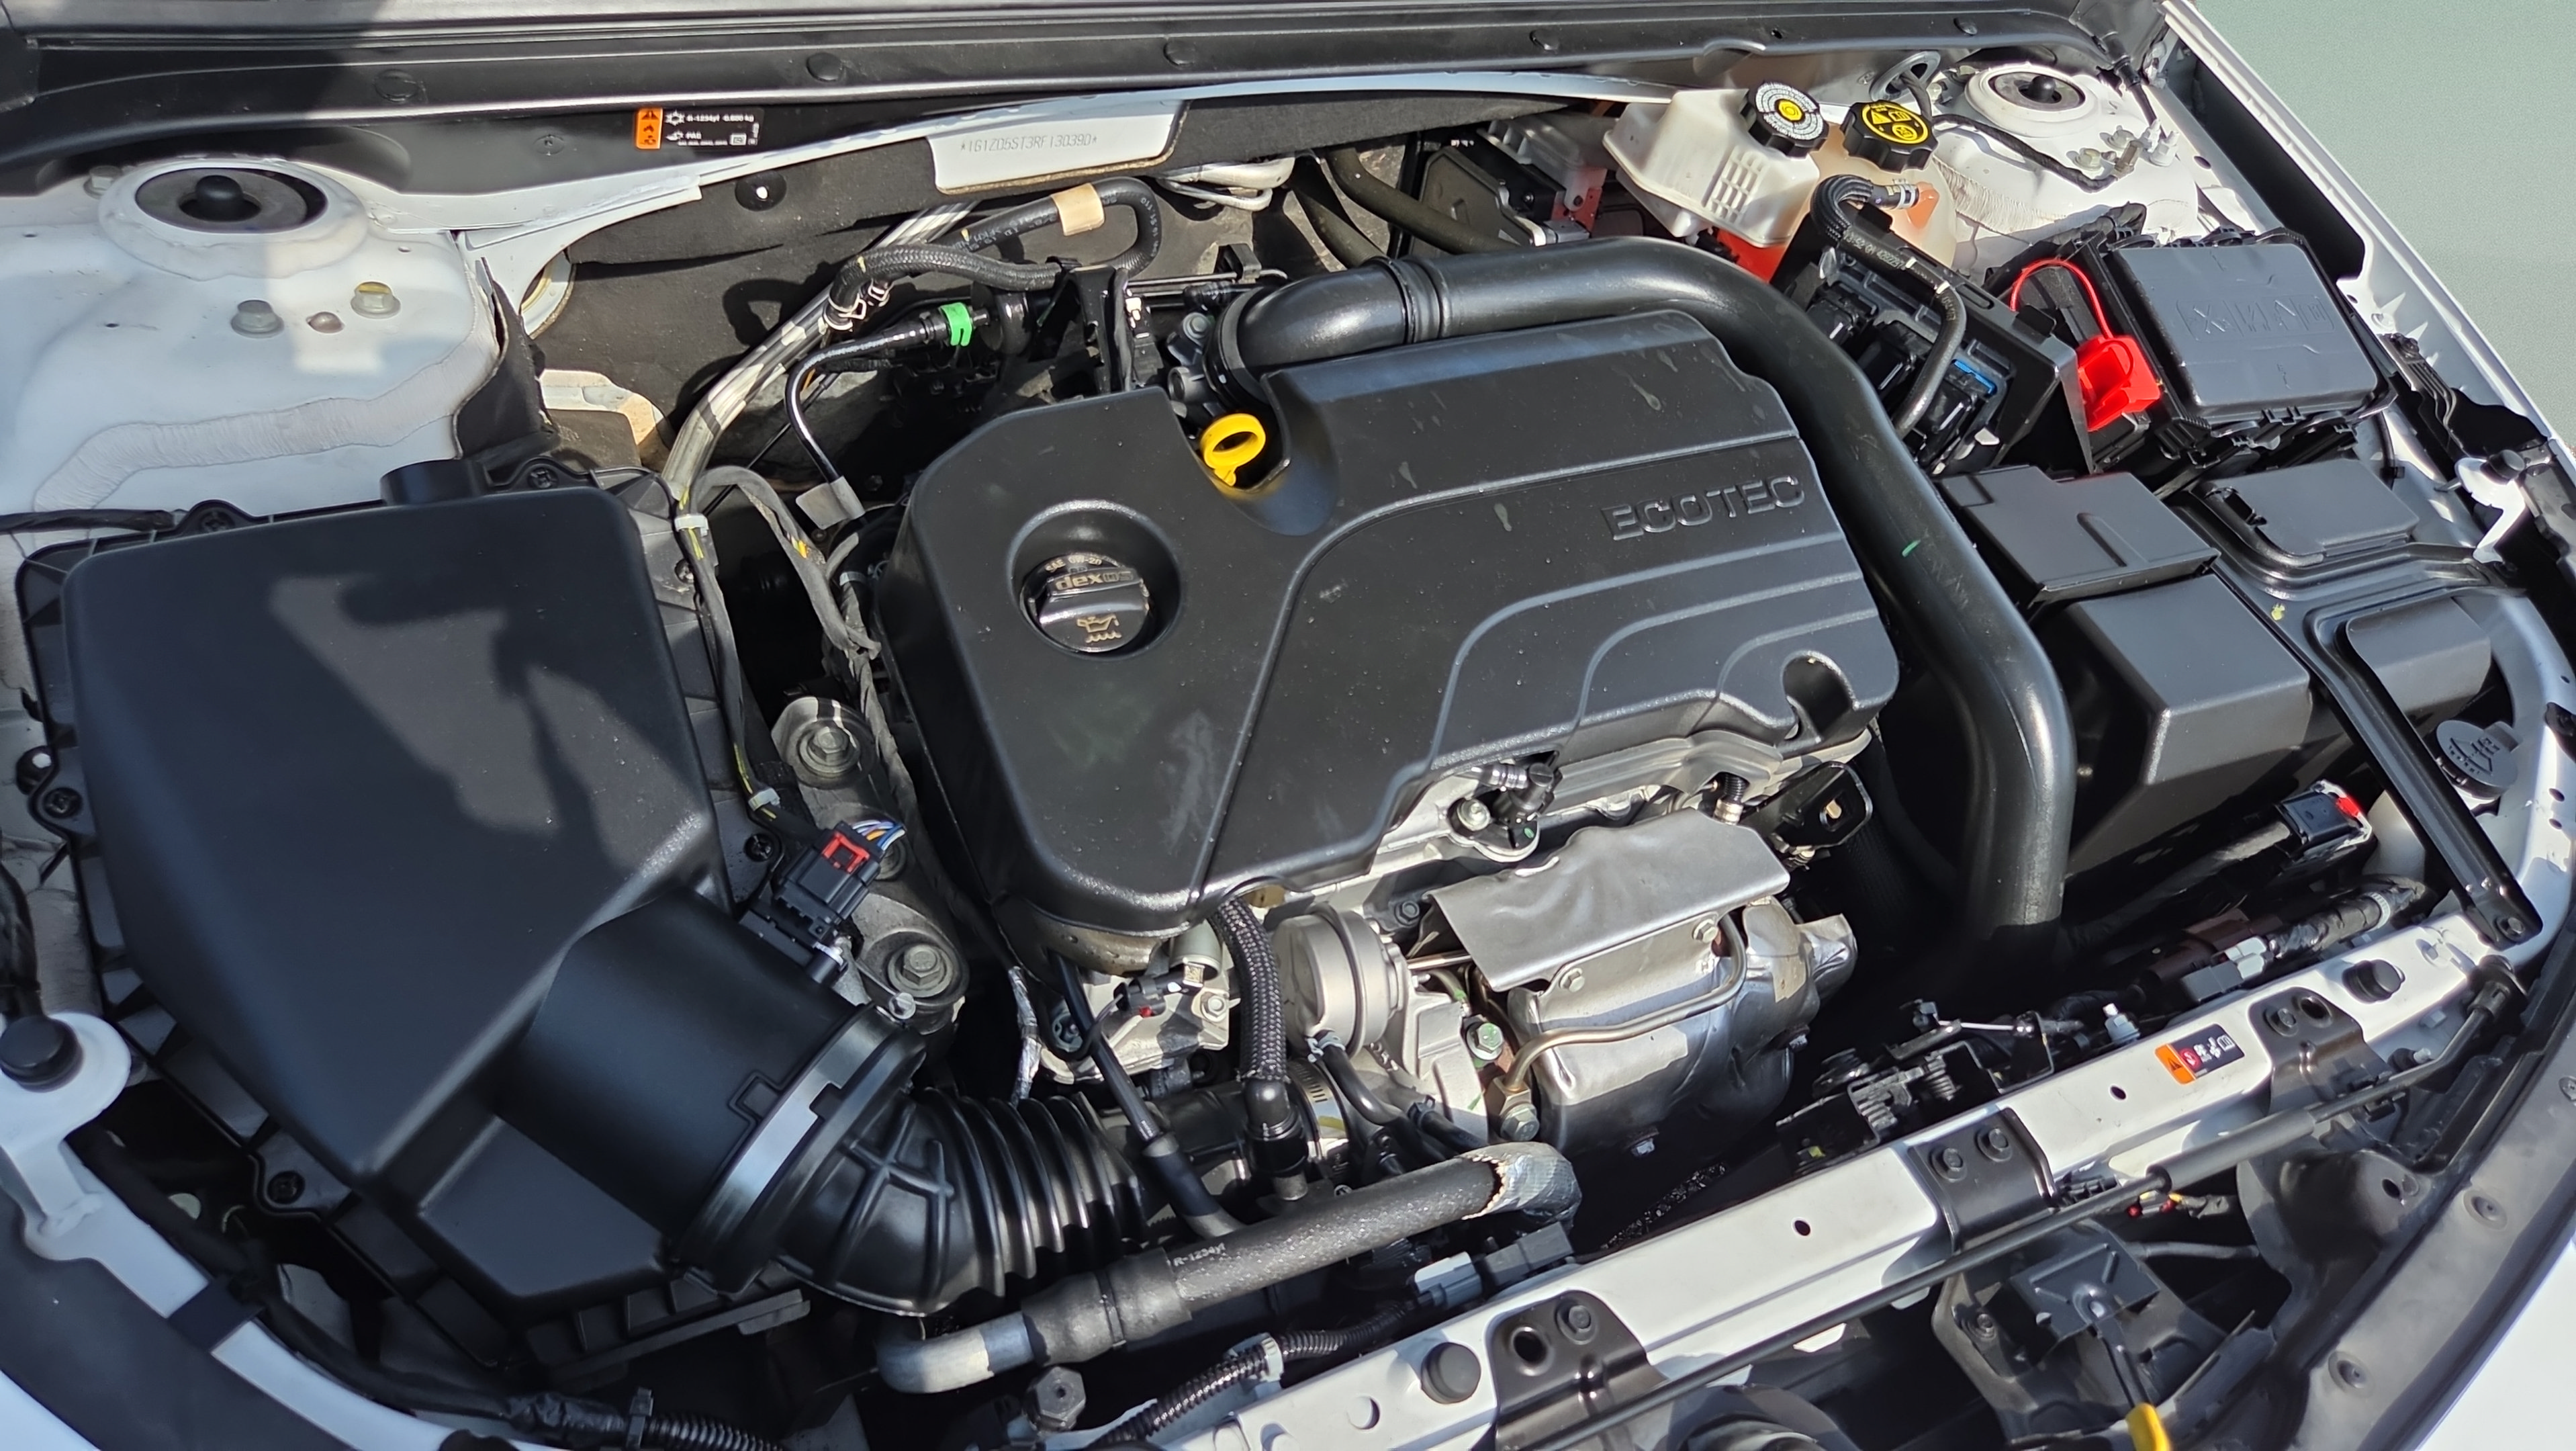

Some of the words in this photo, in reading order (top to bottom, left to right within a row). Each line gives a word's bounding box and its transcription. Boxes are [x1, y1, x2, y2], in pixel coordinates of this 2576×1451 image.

[1601, 475, 1805, 541] ECOTEC
[1045, 558, 1066, 573] SAE
[1068, 555, 1103, 566] 0W-20
[1056, 570, 1134, 591] dexos
